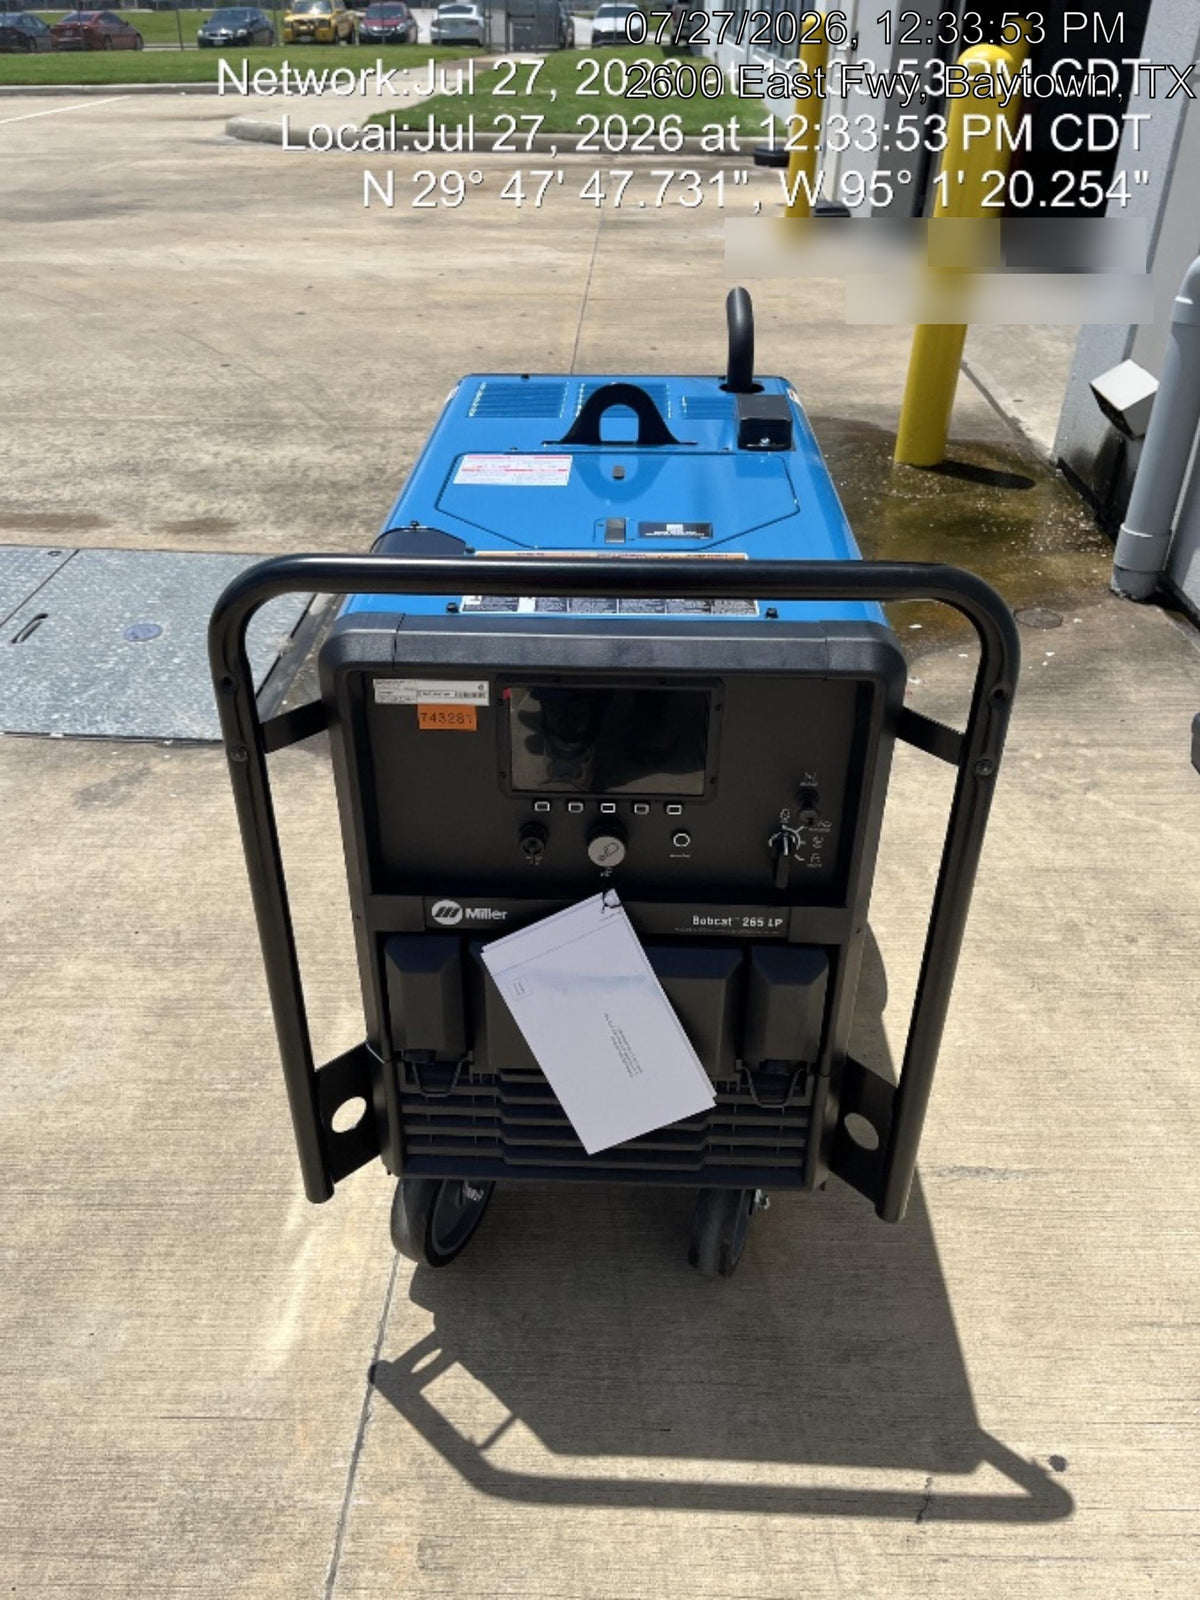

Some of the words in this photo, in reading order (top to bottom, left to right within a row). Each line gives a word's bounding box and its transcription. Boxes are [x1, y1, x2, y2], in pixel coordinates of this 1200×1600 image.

[465, 907, 508, 920] Miller
[692, 915, 732, 926] Bobcat
[742, 916, 765, 928] 265
